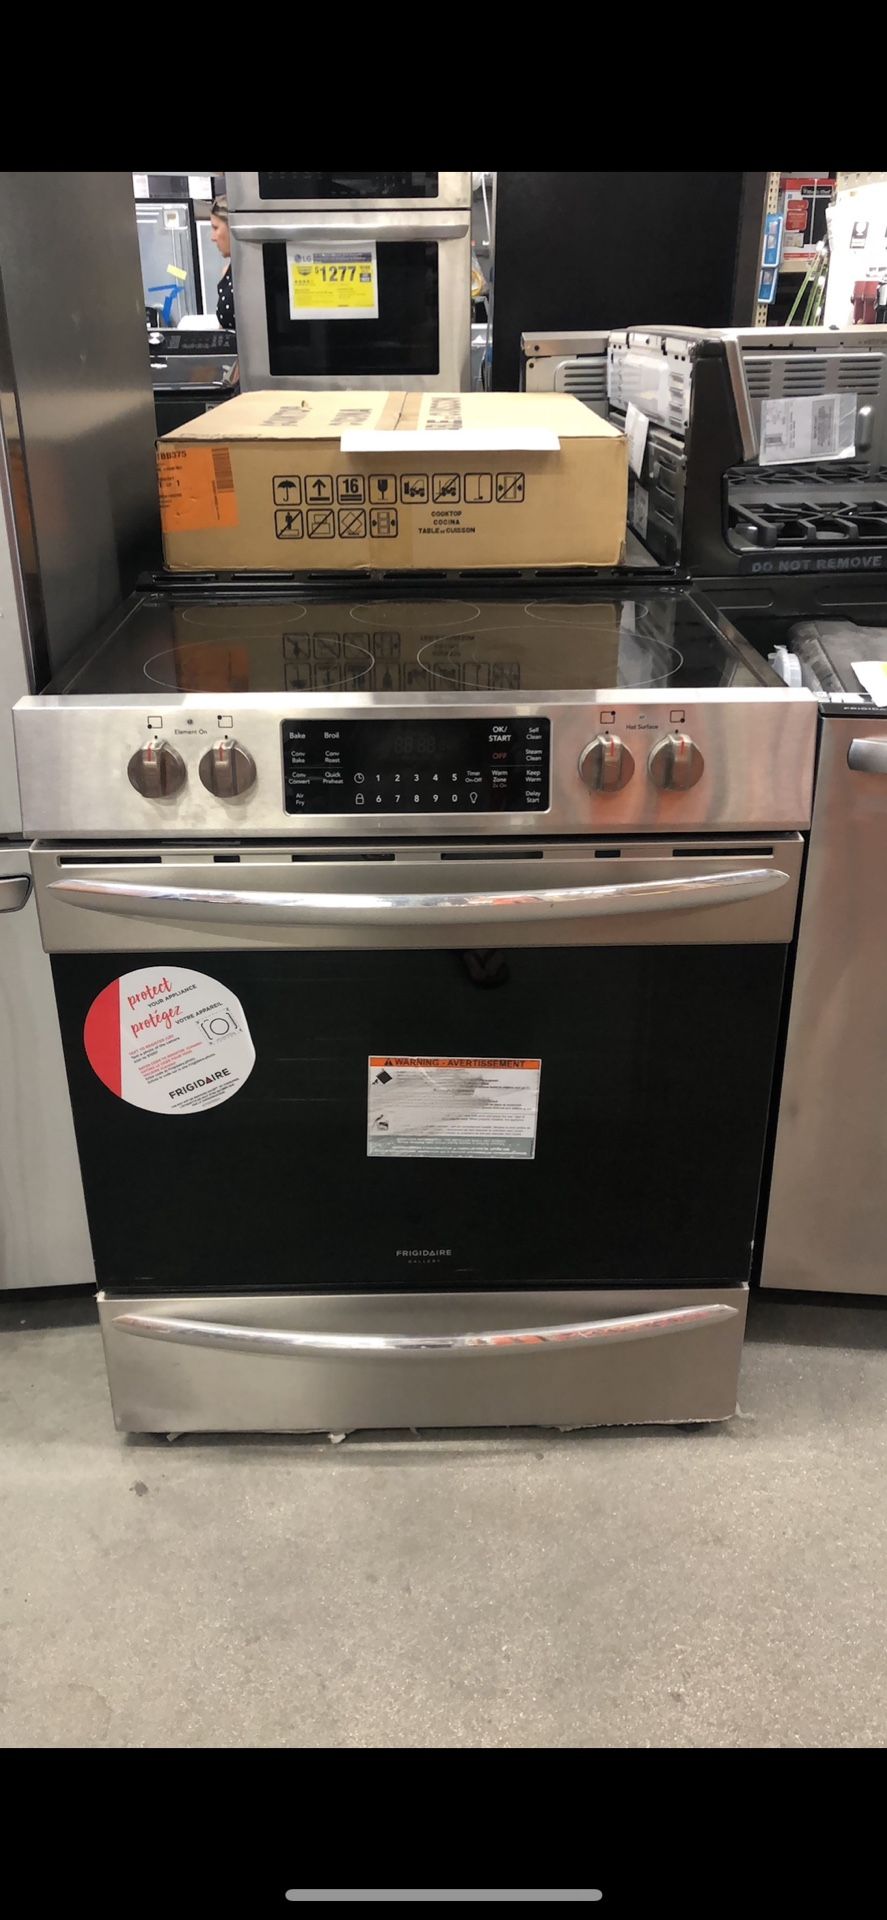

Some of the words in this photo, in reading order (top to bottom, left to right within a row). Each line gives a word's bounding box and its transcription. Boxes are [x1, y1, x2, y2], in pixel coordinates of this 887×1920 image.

[342, 478, 358, 494] 16
[752, 561, 773, 573] DO
[778, 559, 811, 572] NOT
[816, 555, 882, 570] REMOVE
[324, 731, 340, 739] Broil
[488, 734, 512, 742] START
[394, 774, 401, 782] 2
[414, 774, 420, 782] 3
[432, 773, 439, 781] 4
[452, 773, 458, 782] 5
[376, 795, 382, 803] 6
[395, 794, 401, 803] 7
[414, 794, 420, 803] 8
[433, 794, 439, 803] 9
[452, 794, 458, 802] 0
[127, 977, 173, 1011] protect
[148, 998, 164, 1008] YOUR
[165, 984, 198, 1001] APPLIANCE
[175, 1014, 195, 1025] VOTRE
[195, 1001, 223, 1017] APPAREIL
[130, 1005, 182, 1039] protégez
[394, 1057, 440, 1066] WARNING
[447, 1058, 526, 1068] AVERTISSEMENT
[168, 1068, 231, 1099] FRIGIDAIRE
[396, 1249, 452, 1257] FRIGIDAIRE
